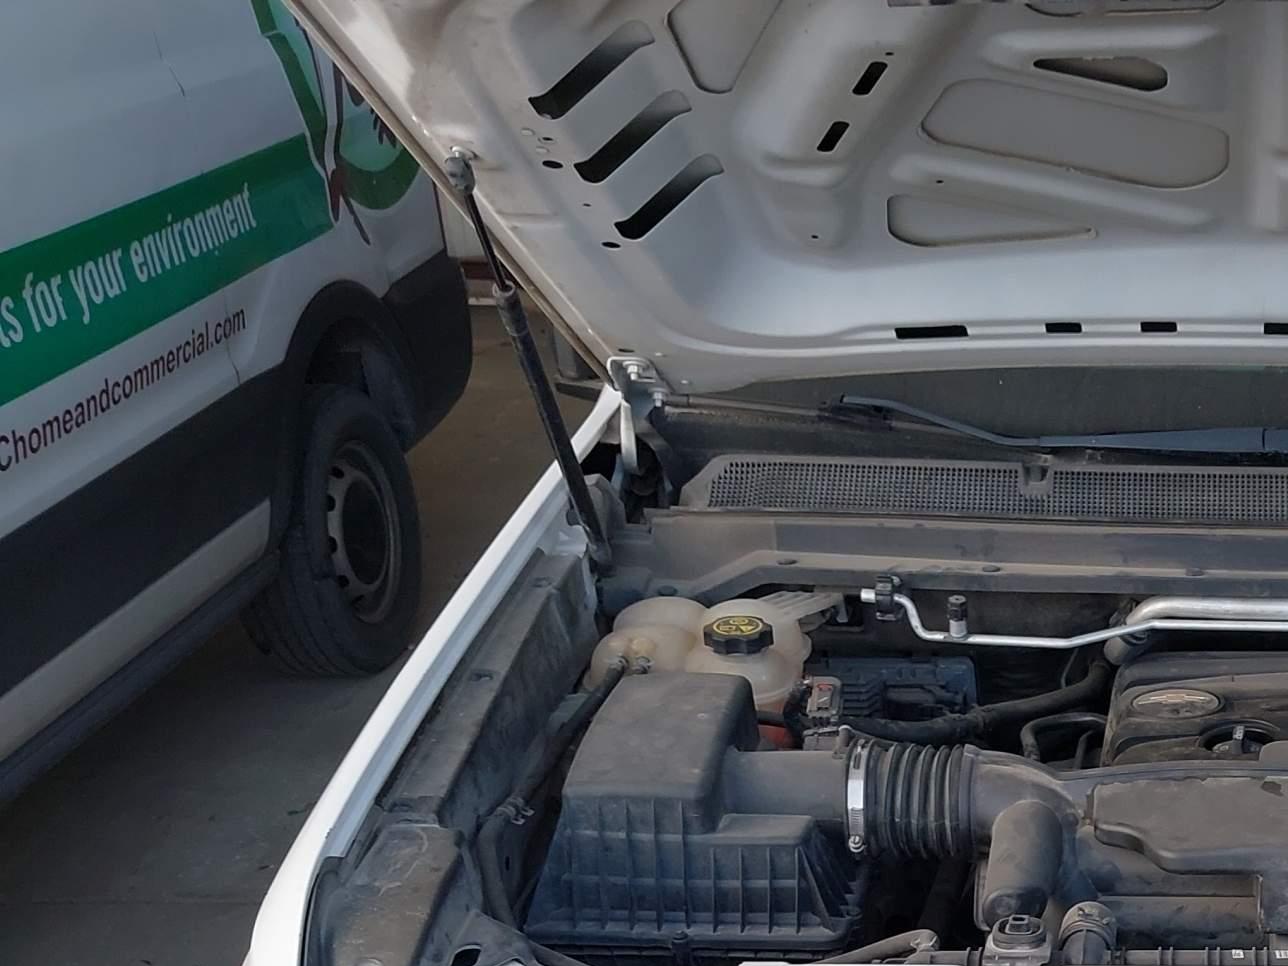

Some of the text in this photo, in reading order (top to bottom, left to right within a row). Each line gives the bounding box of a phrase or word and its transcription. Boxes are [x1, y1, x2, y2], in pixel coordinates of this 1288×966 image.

[22, 272, 68, 333] for
[69, 247, 127, 325] your
[130, 182, 257, 283] environment
